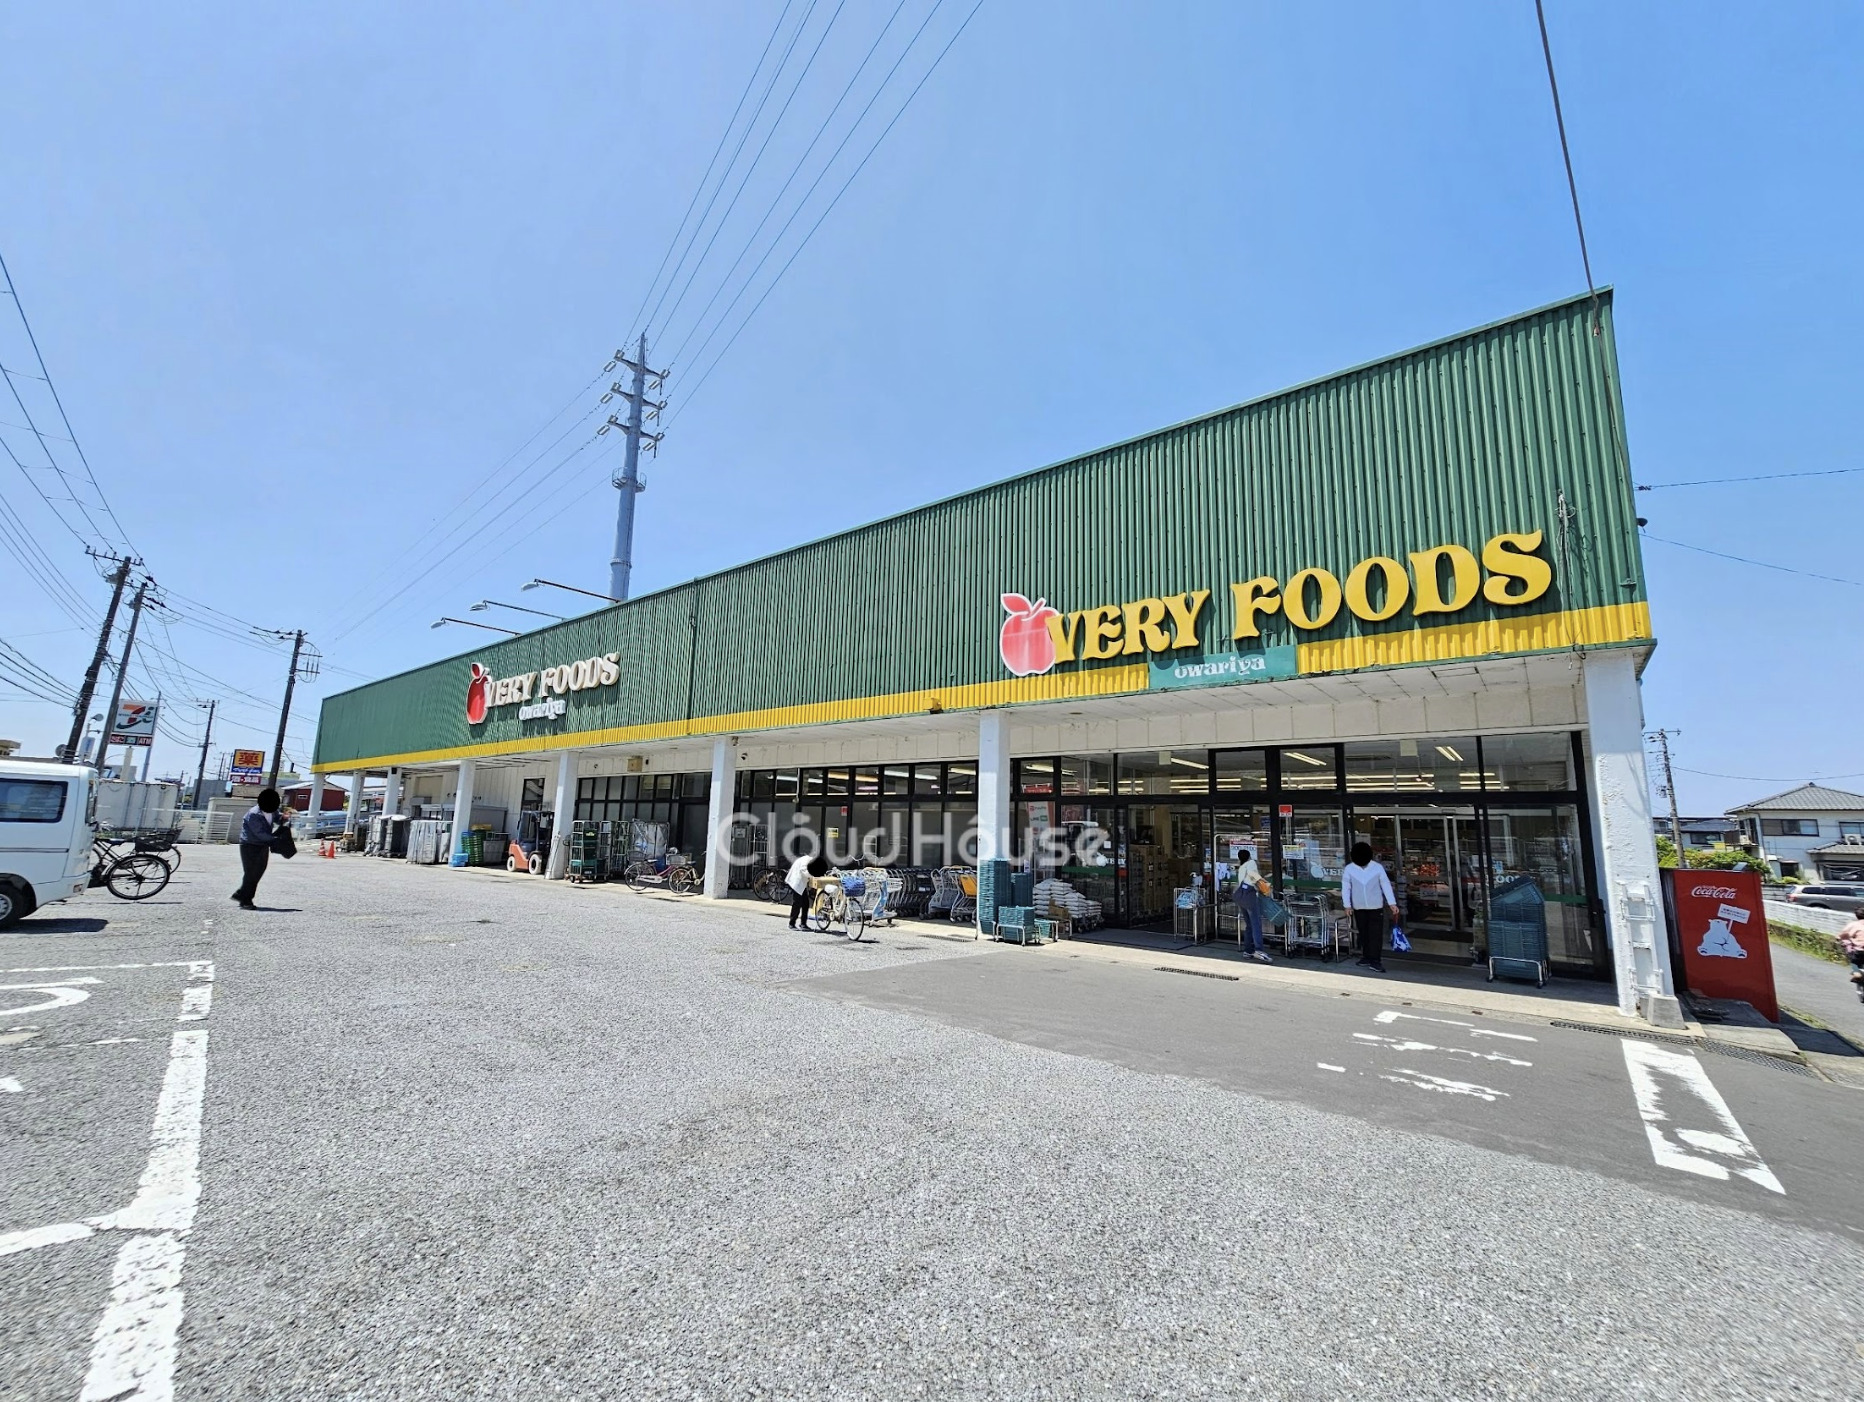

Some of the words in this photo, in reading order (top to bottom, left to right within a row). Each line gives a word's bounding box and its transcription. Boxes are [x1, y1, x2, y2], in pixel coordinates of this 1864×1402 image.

[1045, 589, 1211, 664] VERY
[1230, 529, 1552, 640] FOODS
[484, 671, 538, 708] VERY
[538, 651, 620, 698] FOODS
[1174, 655, 1266, 679] owariya
[1691, 885, 1738, 899] Coca-Cola
